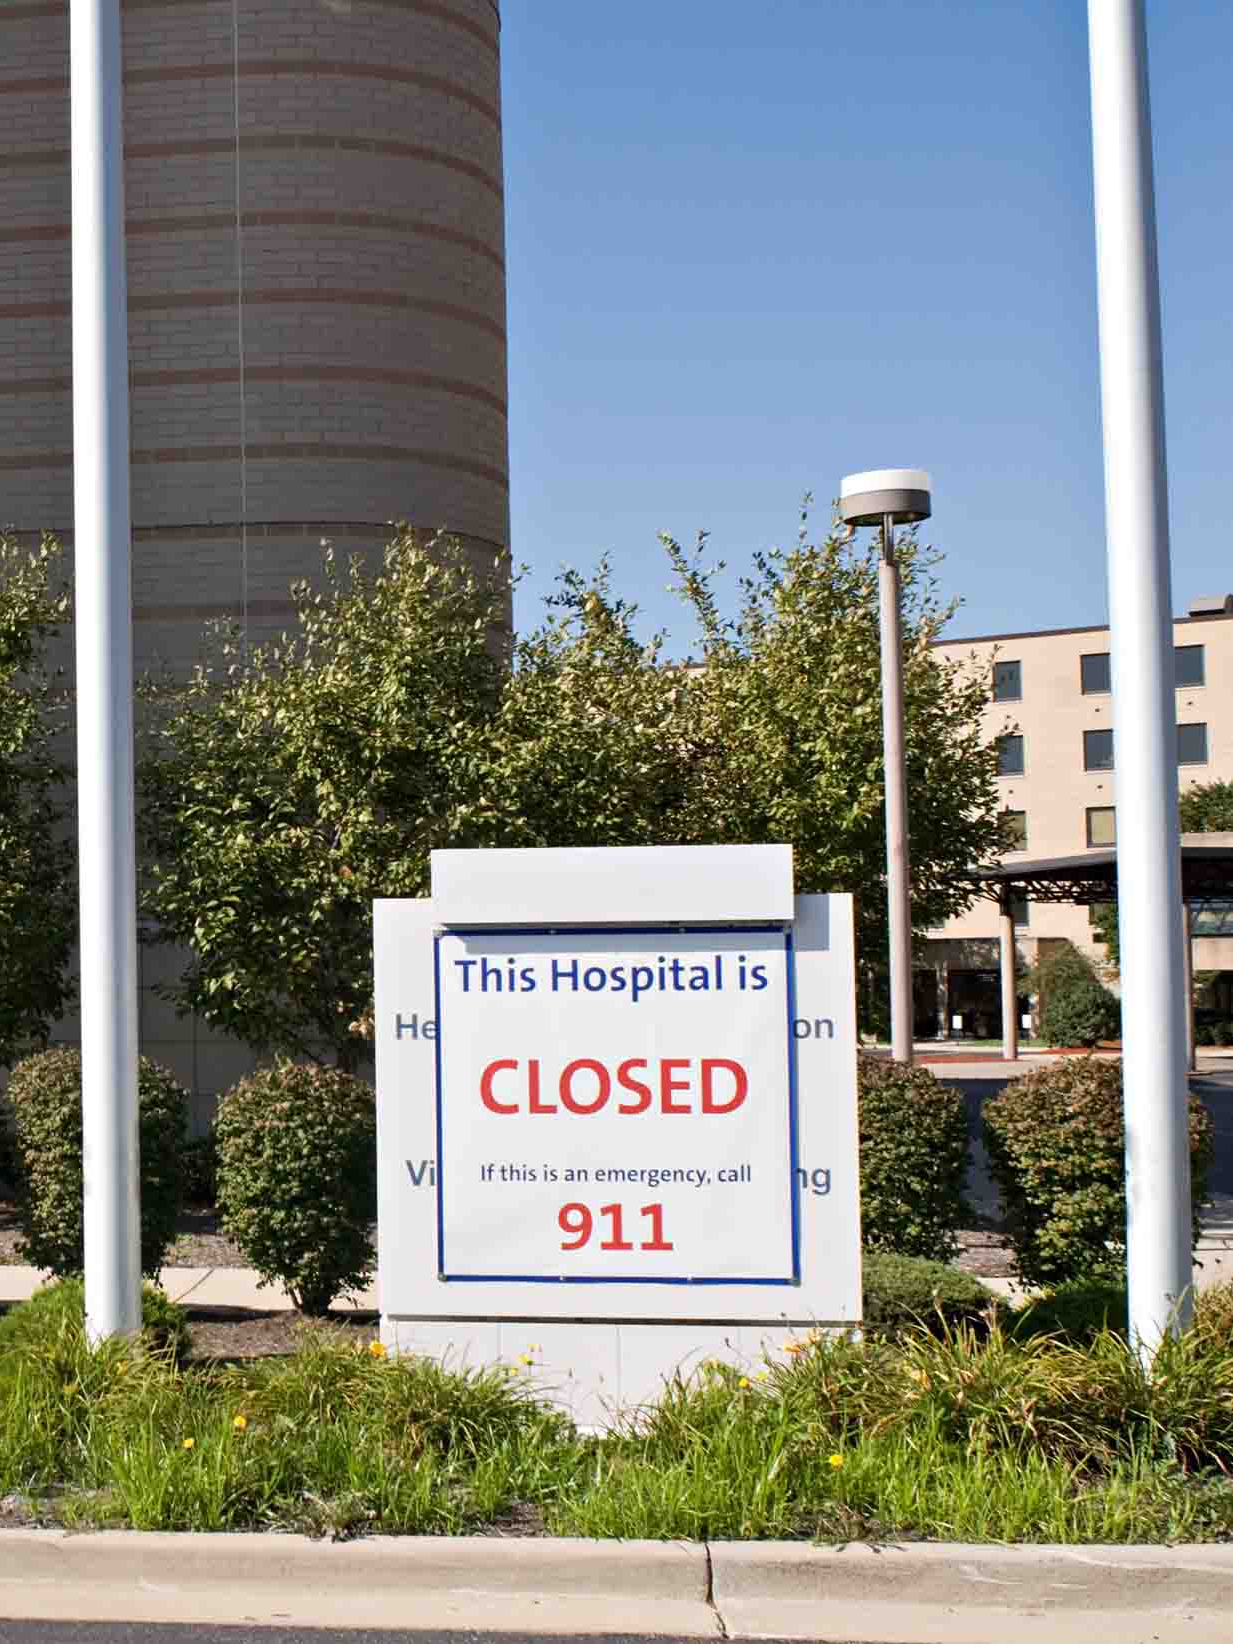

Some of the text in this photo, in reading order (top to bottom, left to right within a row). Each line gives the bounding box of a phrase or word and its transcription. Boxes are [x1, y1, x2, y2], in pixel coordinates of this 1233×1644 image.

[453, 954, 769, 1003] This Hospital is
[479, 1058, 749, 1116] CLOSED
[480, 1163, 752, 1190] If this is an emergency, call
[557, 1202, 675, 1252] 911
